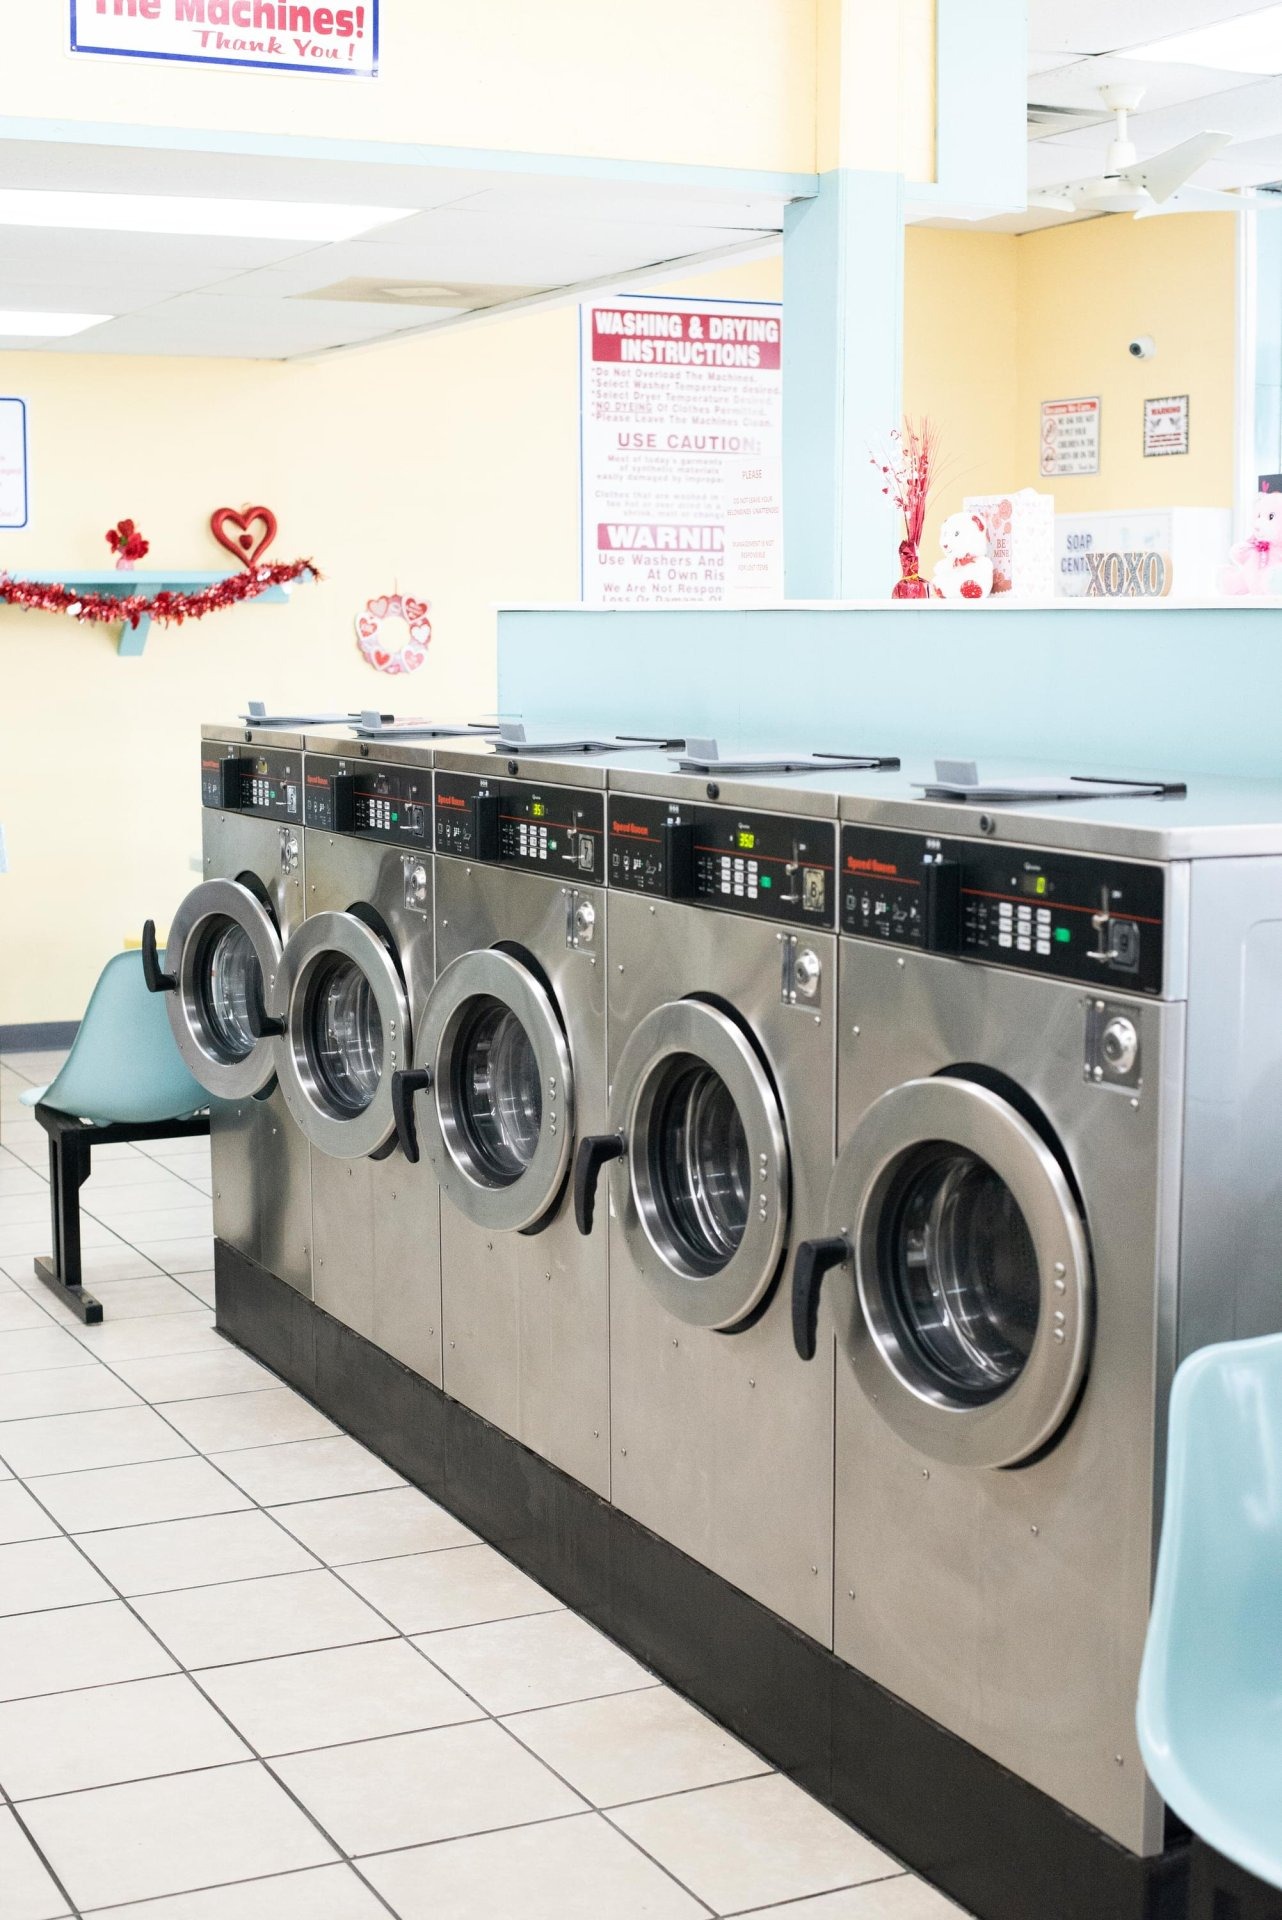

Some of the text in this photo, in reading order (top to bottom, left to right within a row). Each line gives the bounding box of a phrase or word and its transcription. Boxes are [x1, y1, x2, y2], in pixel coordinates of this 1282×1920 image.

[175, 0, 364, 38] Machines!
[192, 29, 286, 54] Thank
[595, 311, 779, 342] WASHING & DRYING
[620, 338, 760, 367] INSTRUCTIONS
[614, 369, 630, 377] Not
[635, 370, 681, 379] Overload
[686, 371, 703, 380] The
[634, 381, 670, 390] Washer
[675, 382, 737, 393] Temperature
[634, 392, 661, 402] Dryer
[666, 393, 733, 403] Temperature
[616, 403, 652, 412] DYEING
[673, 405, 710, 414] Clothes
[635, 415, 664, 424] Leave
[670, 416, 686, 424] The
[692, 417, 738, 426] Machines
[618, 432, 656, 448] USE
[628, 474, 668, 482] damaged
[742, 470, 762, 479] PLEASE
[595, 490, 629, 498] Clothes
[996, 539, 1006, 548] BE
[1066, 534, 1092, 550] SOAP
[598, 553, 724, 567] Use Washers And
[647, 569, 660, 580] At
[667, 569, 698, 580] Own
[1085, 552, 1164, 597] XOXO
[604, 584, 620, 592] We
[627, 584, 646, 592] Are
[652, 584, 672, 592] Not
